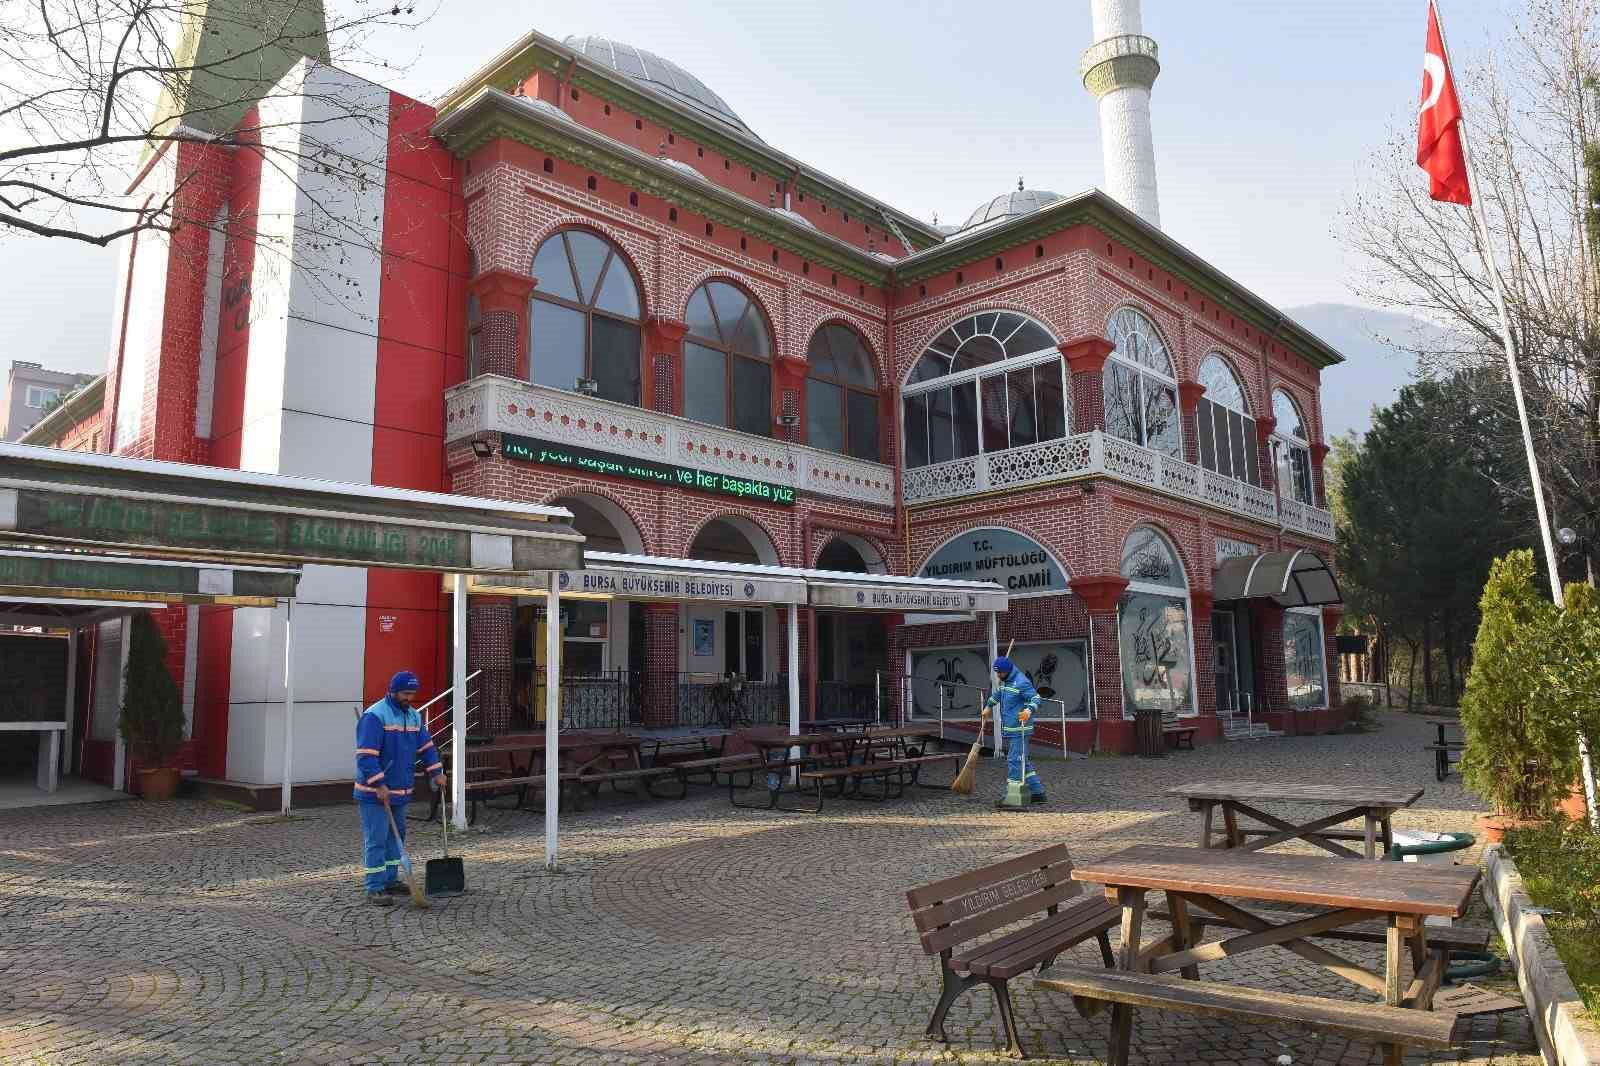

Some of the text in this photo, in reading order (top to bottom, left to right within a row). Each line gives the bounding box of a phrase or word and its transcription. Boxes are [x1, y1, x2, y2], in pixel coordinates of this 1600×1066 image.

[676, 469, 693, 483] ve
[696, 469, 719, 489] her
[722, 473, 770, 497] başakta
[773, 484, 794, 502] yüz
[973, 539, 993, 553] T.C.
[583, 574, 616, 590] BURSA
[685, 580, 733, 597] BELEDİYESİ
